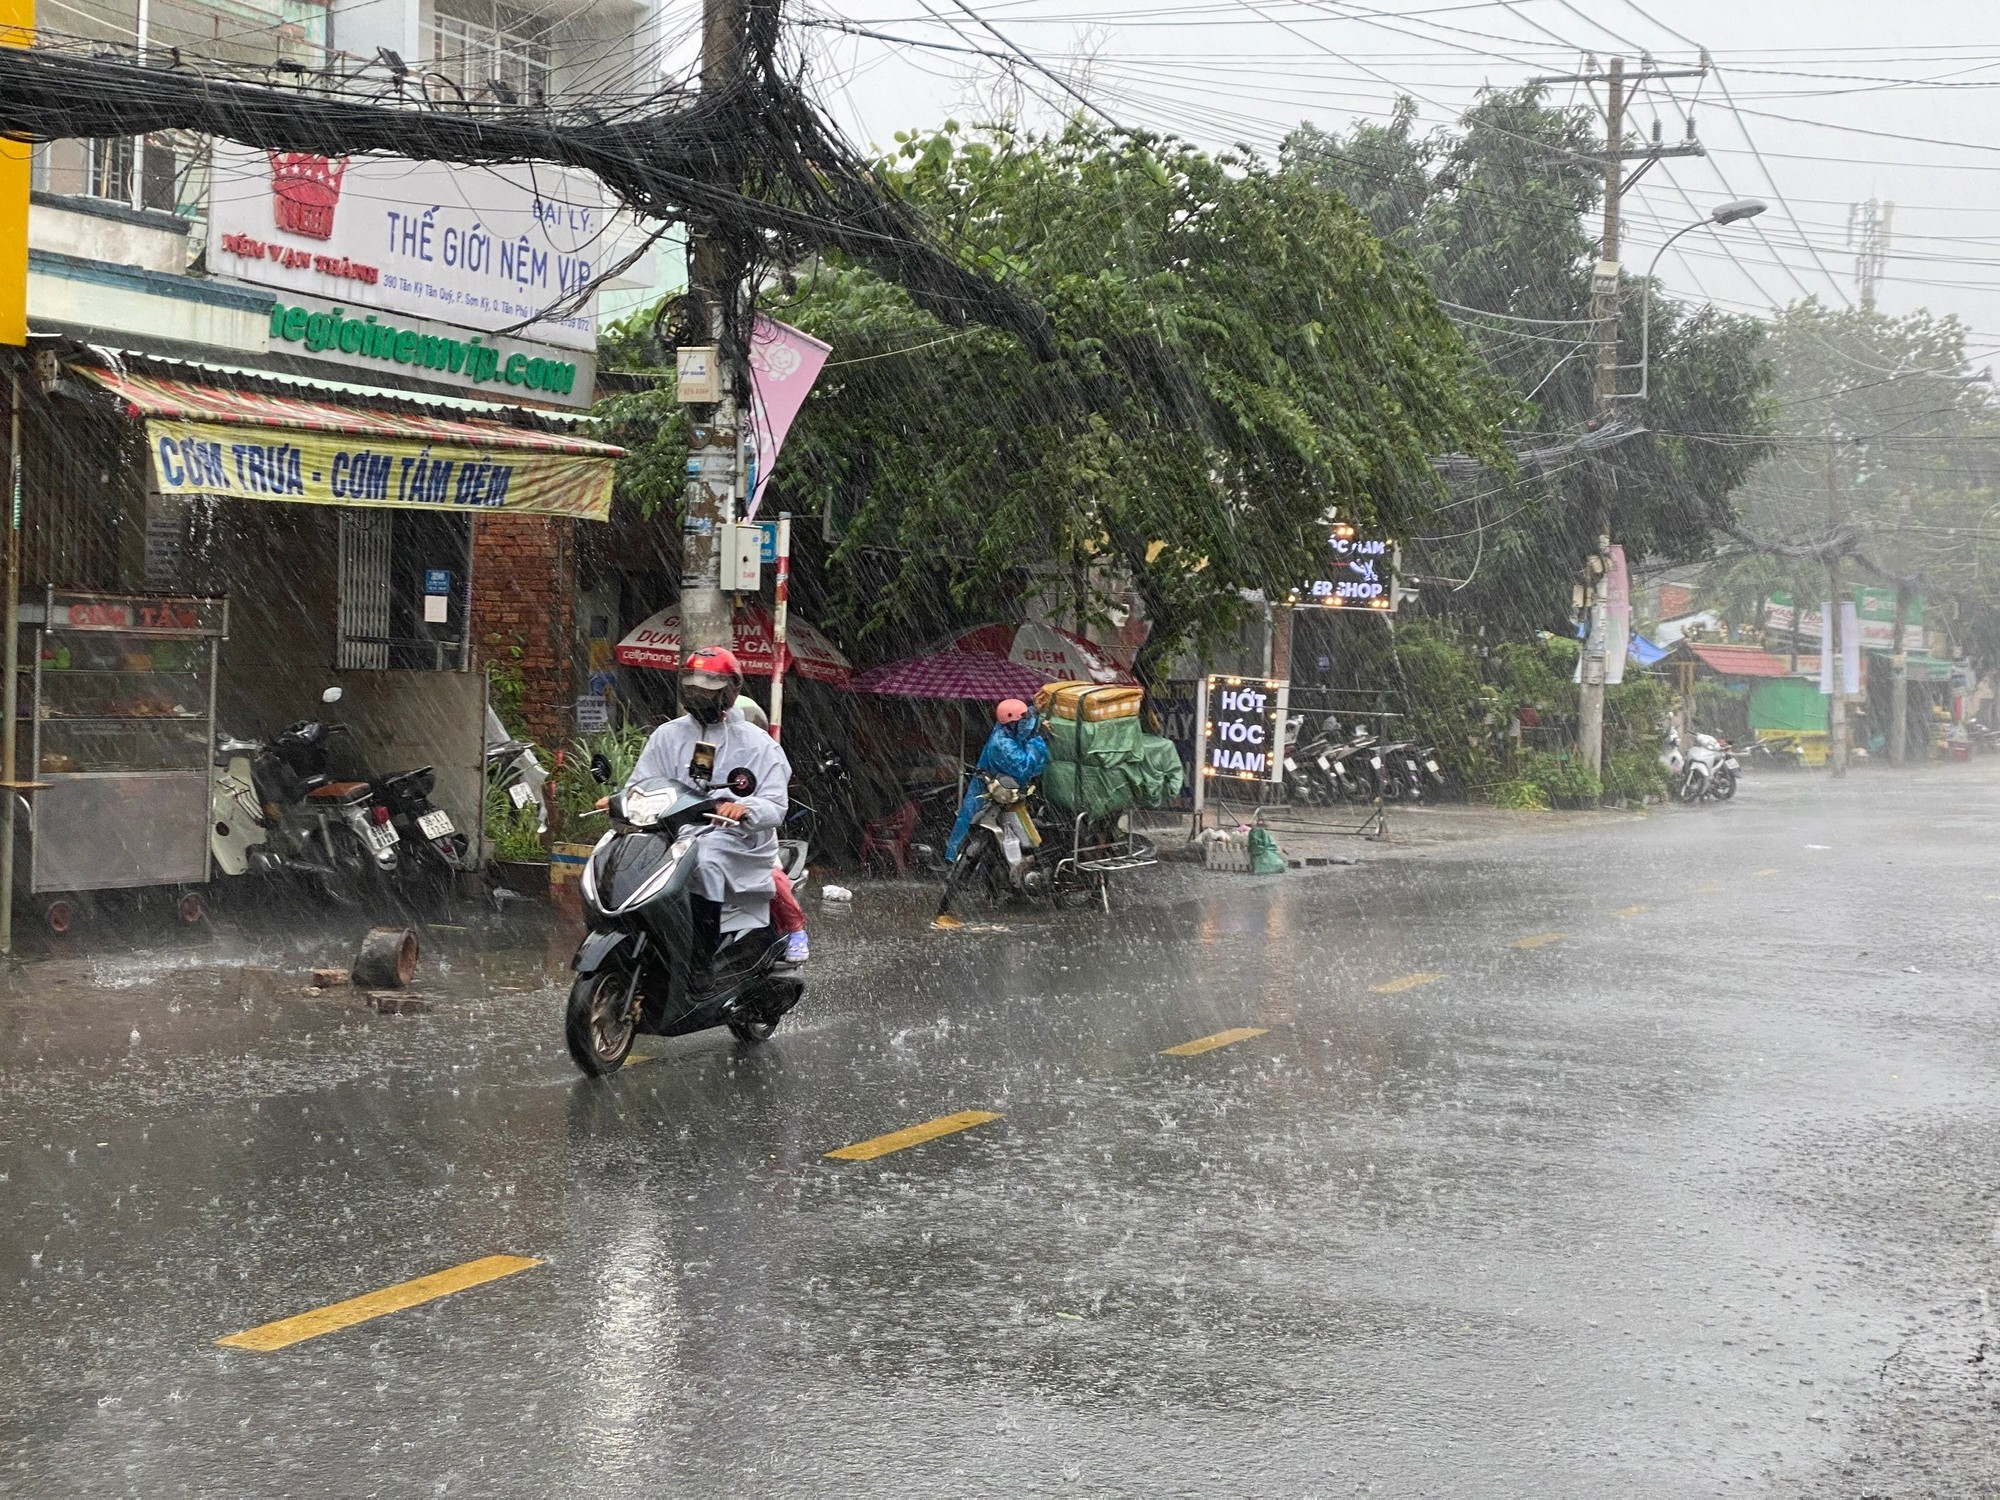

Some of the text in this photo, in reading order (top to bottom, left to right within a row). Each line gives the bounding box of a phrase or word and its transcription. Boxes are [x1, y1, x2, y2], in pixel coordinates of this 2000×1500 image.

[532, 199, 562, 229] ĐẠI
[268, 244, 312, 269] VẠN
[387, 205, 440, 262] THẾ
[443, 222, 490, 275] GIỚI
[500, 235, 548, 293] NỆM
[557, 254, 591, 296] VIP
[383, 274, 397, 289] 390
[399, 277, 412, 292] Tân
[425, 284, 438, 298] Tân
[502, 301, 514, 315] Tân
[515, 304, 529, 318] Phú
[158, 434, 231, 489] CƠM
[231, 442, 304, 496] TRƯA
[331, 449, 394, 501] CƠM
[397, 443, 454, 503] TẤM
[1221, 687, 1267, 713] HỚT
[1218, 718, 1266, 745] TÓC
[1213, 748, 1266, 772] NAM
